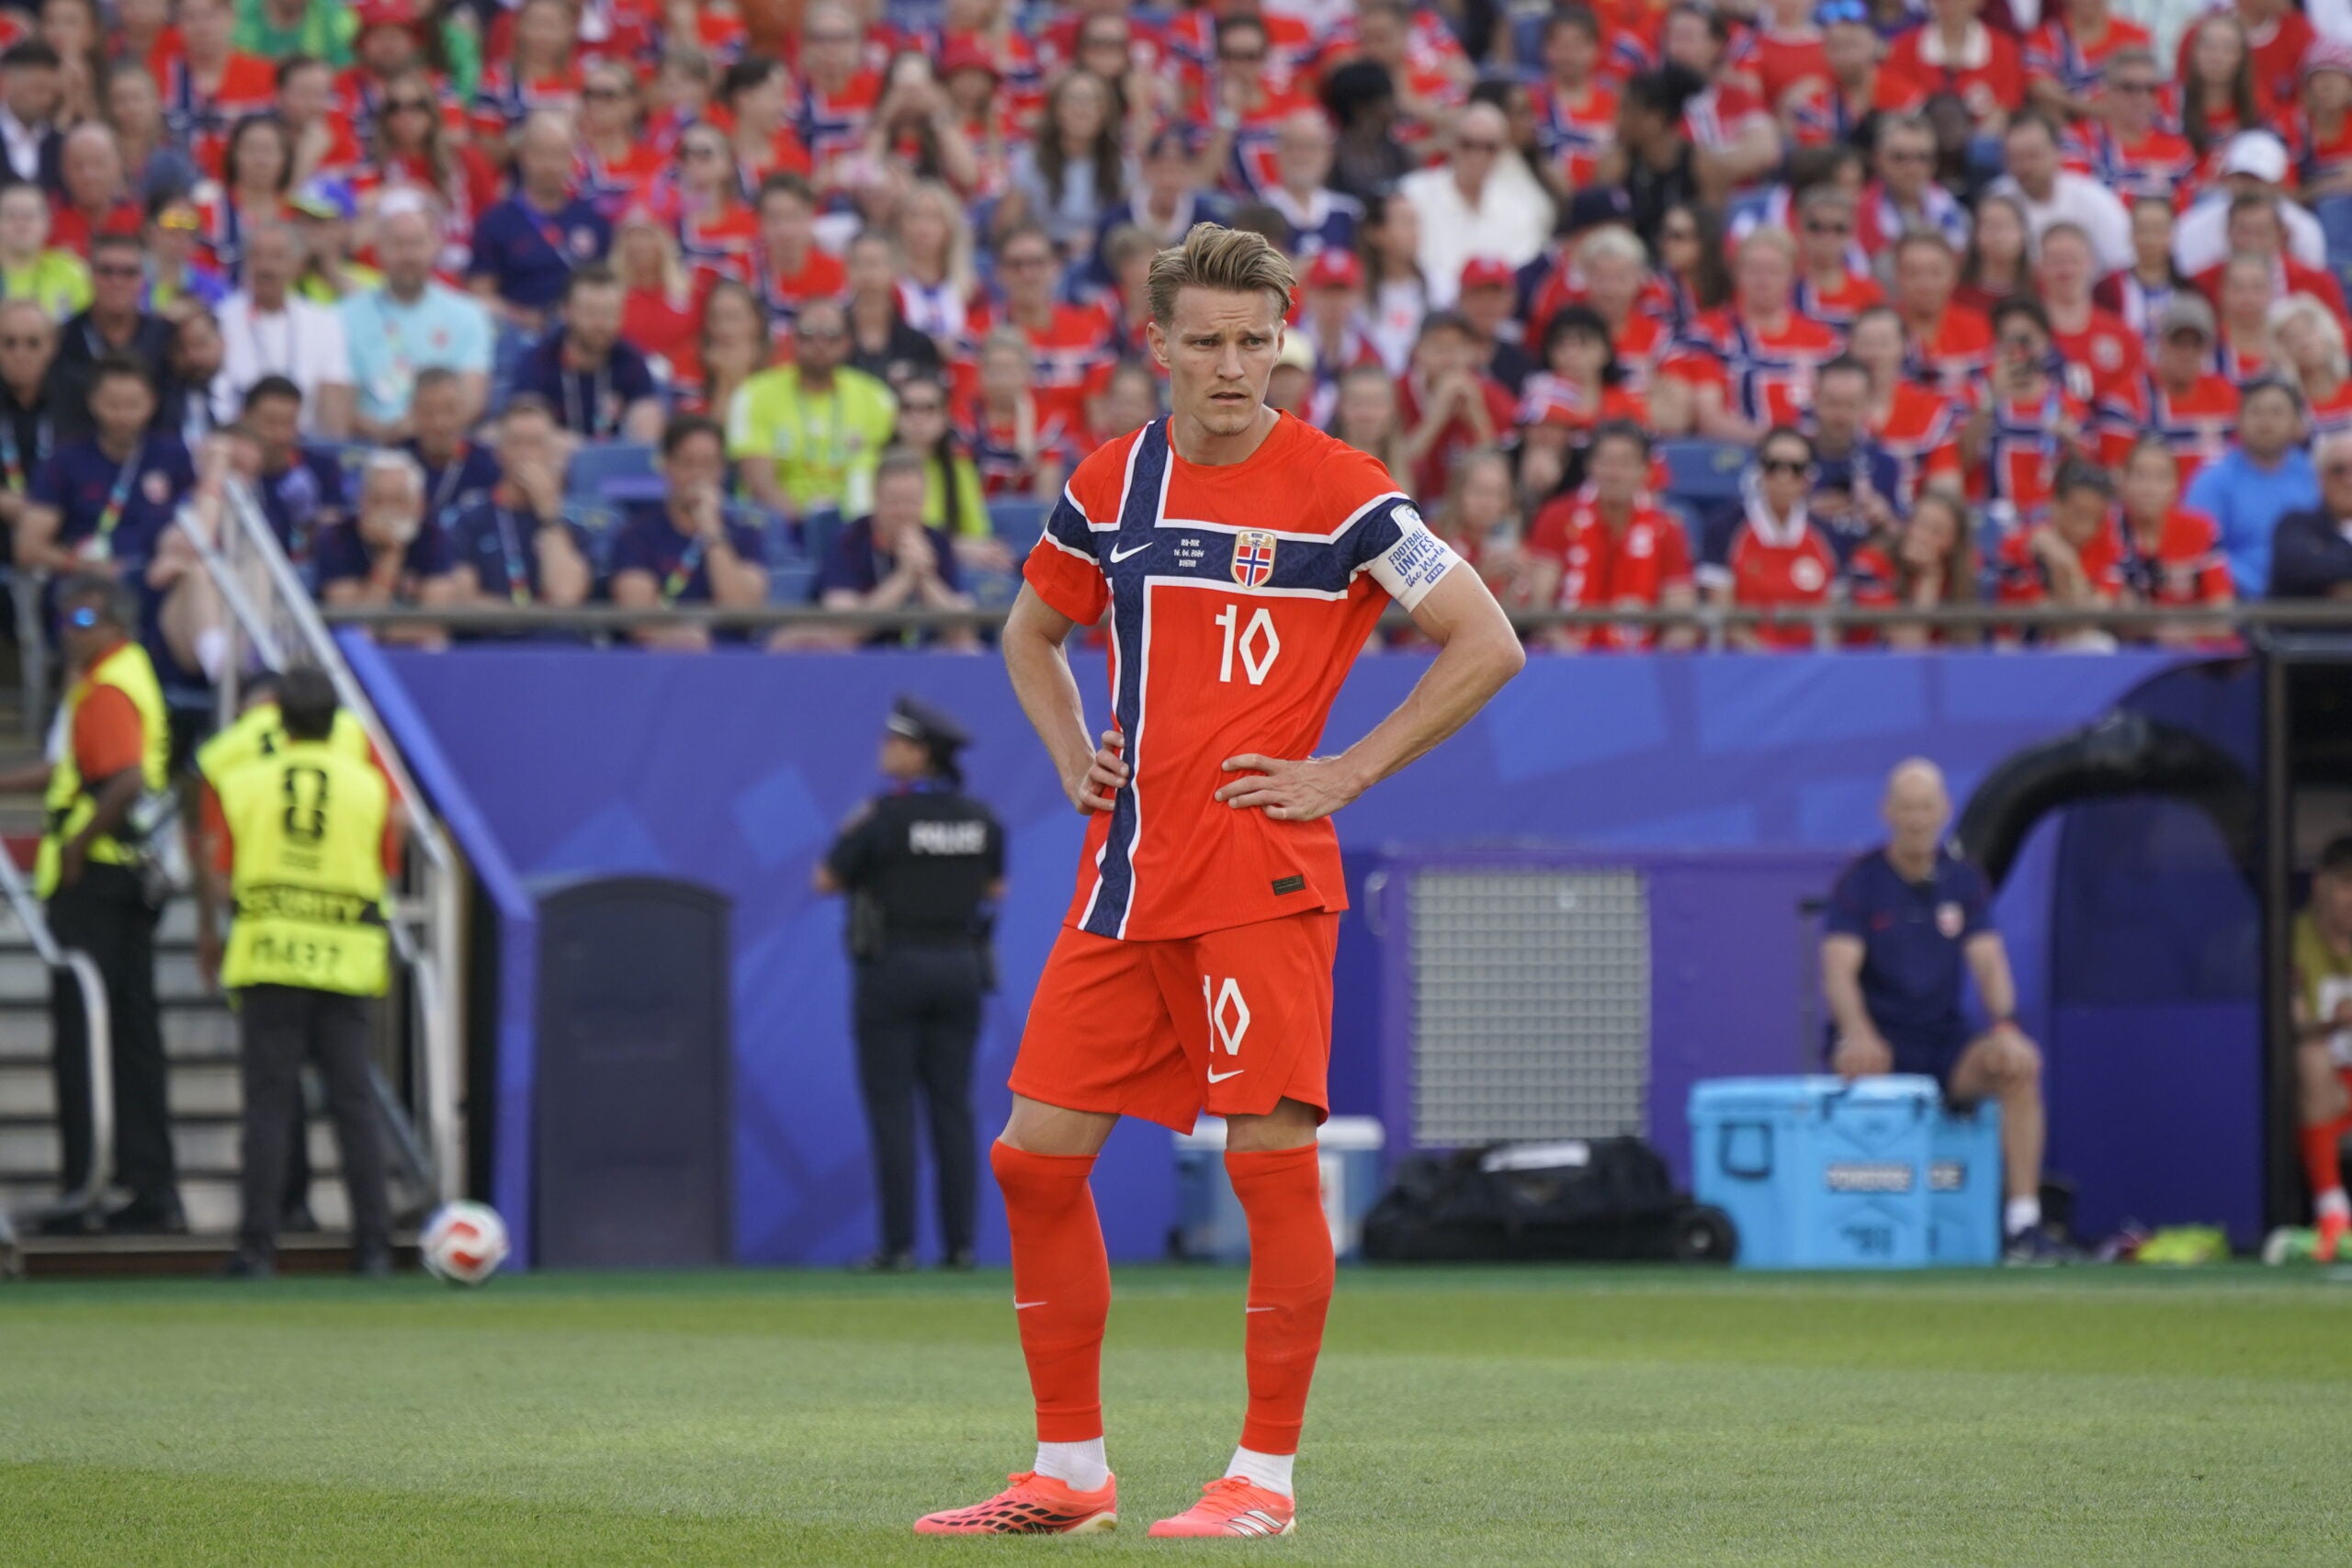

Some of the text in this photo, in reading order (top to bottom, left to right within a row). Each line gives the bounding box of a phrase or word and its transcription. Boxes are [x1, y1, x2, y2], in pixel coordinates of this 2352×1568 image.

[1388, 527, 1425, 566] FOOTBALL
[1395, 536, 1435, 577] UNITES
[1404, 546, 1447, 588] the World
[1425, 563, 1446, 583] FIFA
[1215, 604, 1280, 685] 10
[1203, 975, 1250, 1055] 10
